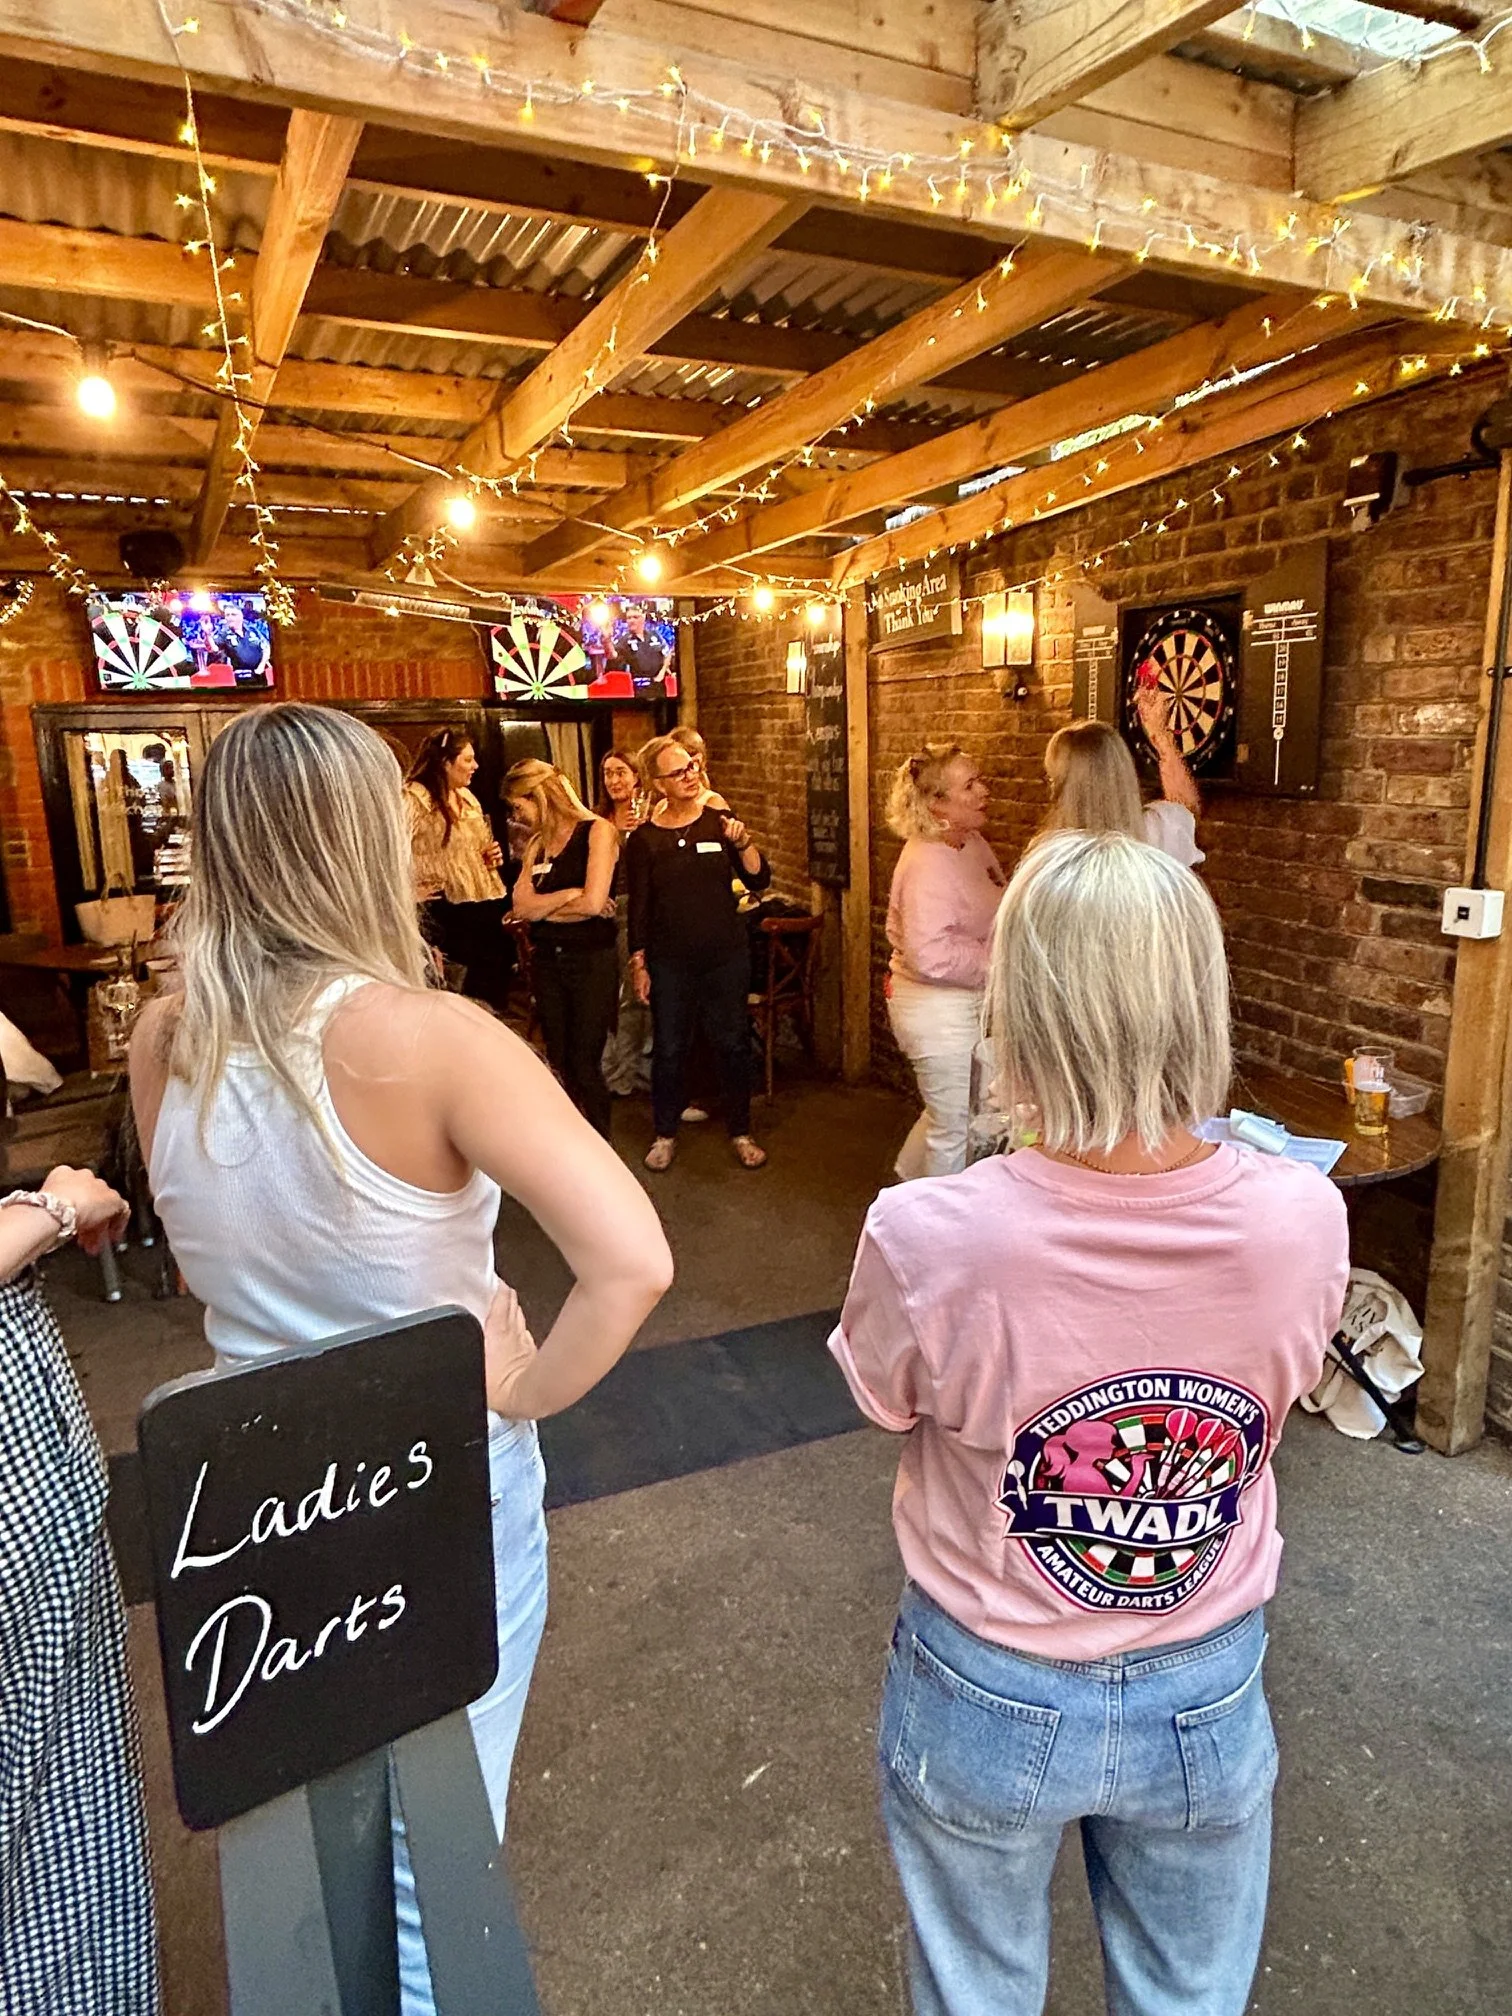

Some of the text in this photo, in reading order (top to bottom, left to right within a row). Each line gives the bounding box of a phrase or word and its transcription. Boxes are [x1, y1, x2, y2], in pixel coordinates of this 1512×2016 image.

[883, 580, 923, 607] Smoking
[922, 574, 947, 597] Area
[884, 596, 934, 635] Thank You
[1029, 1378, 1260, 1438] TEDDINGTON WOMEN'S
[170, 1441, 433, 1579] Ladies
[1043, 1495, 1223, 1542] TWADL
[1037, 1540, 1223, 1608] AMATEUR DARTS LEAGUE
[185, 1584, 407, 1734] Darts
